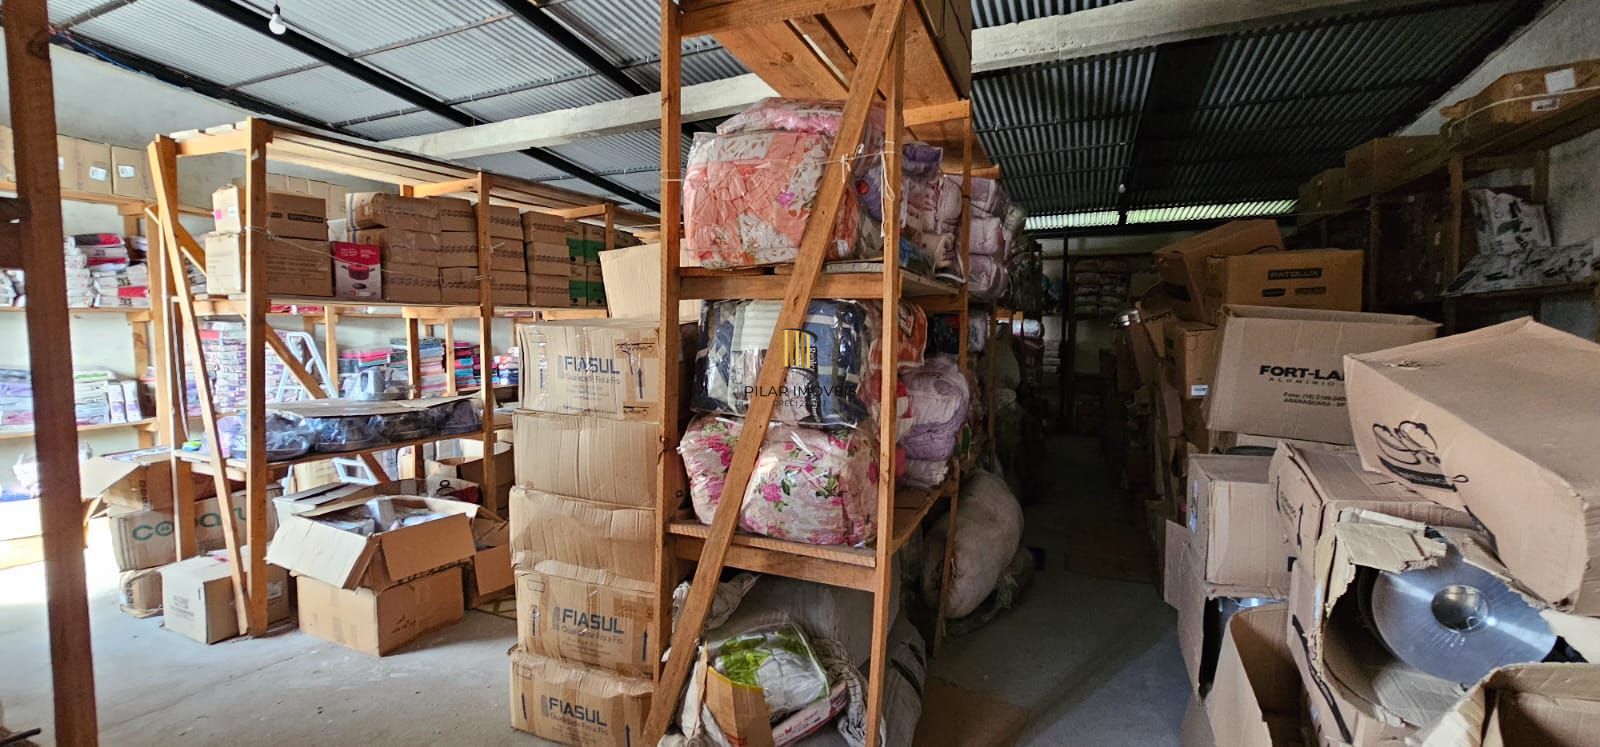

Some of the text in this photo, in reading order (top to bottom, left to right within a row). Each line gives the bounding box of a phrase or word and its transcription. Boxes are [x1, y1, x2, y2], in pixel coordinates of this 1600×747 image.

[564, 356, 620, 374] FIASUL
[1259, 365, 1345, 381] FORT-LA
[562, 608, 625, 634] FIASUL
[549, 697, 608, 727] FIASUL
